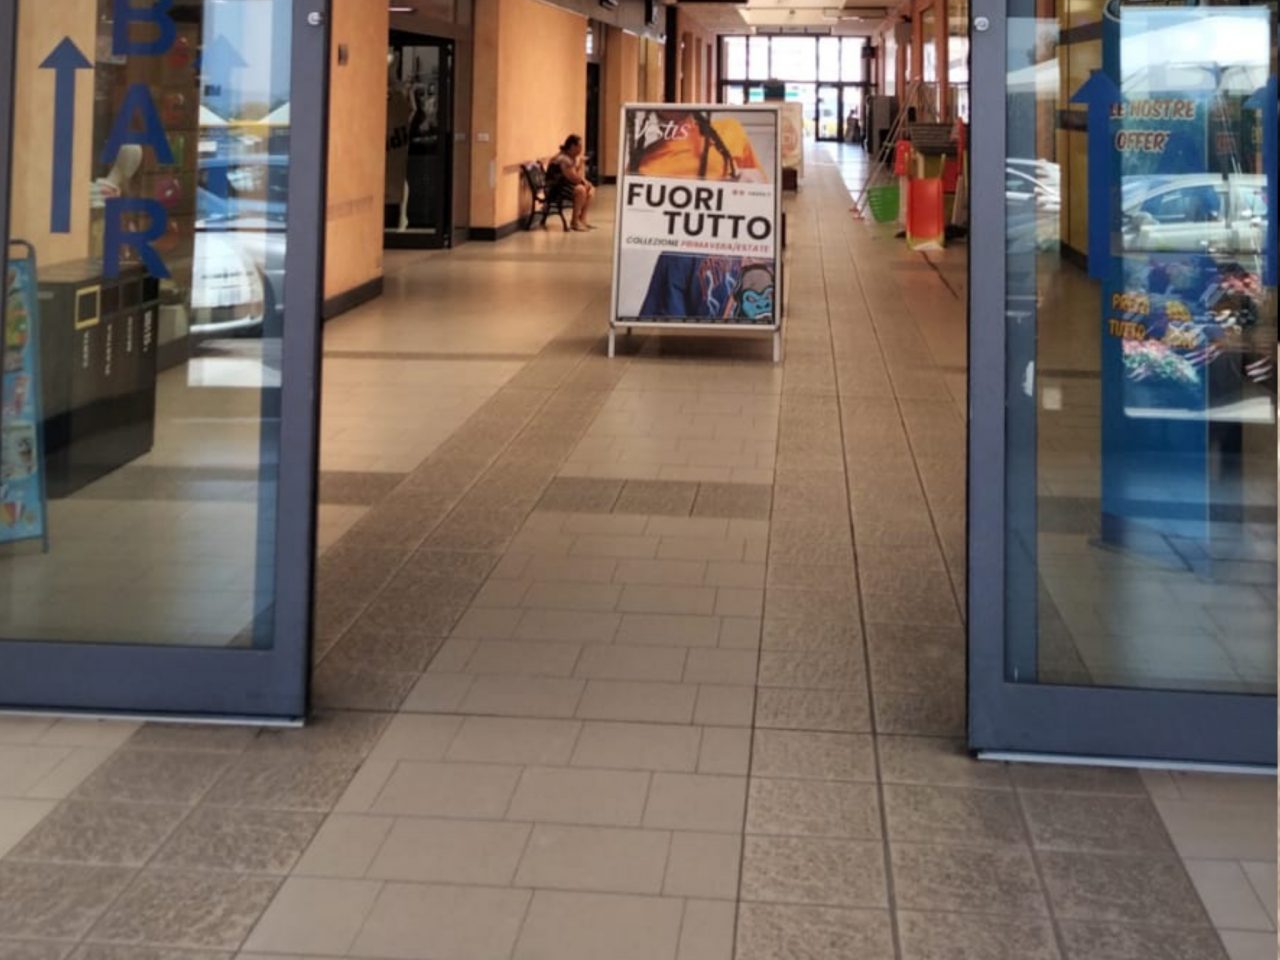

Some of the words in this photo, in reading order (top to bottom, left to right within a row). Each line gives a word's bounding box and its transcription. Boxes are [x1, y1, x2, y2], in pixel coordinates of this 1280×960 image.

[1129, 98, 1197, 121] NOSTRE
[634, 115, 690, 142] Vstis
[1115, 130, 1170, 154] OFFER
[627, 183, 723, 211] FUORI
[663, 210, 772, 240] TUTTO
[626, 236, 679, 247] COLLEZIONE
